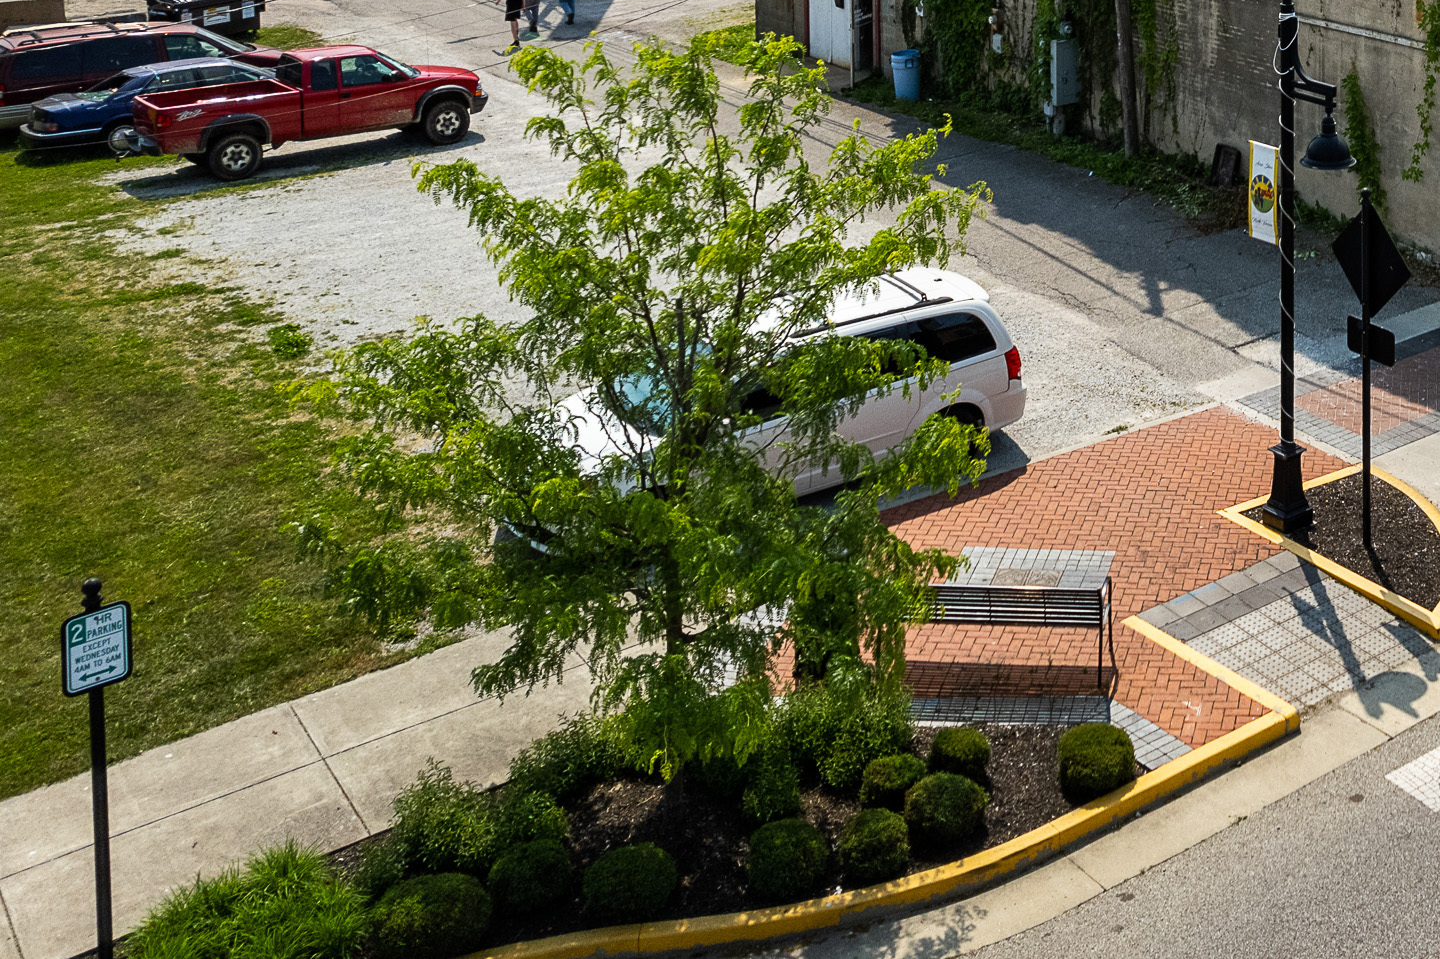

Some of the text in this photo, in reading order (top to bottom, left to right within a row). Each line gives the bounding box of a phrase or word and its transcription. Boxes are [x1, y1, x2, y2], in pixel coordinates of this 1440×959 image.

[96, 613, 112, 626] HR
[70, 620, 123, 644] 2 PARKING
[74, 644, 120, 664] WEDNESDAY
[82, 638, 111, 653] EXCEPT
[74, 653, 122, 674] 4AM TO 6AM
